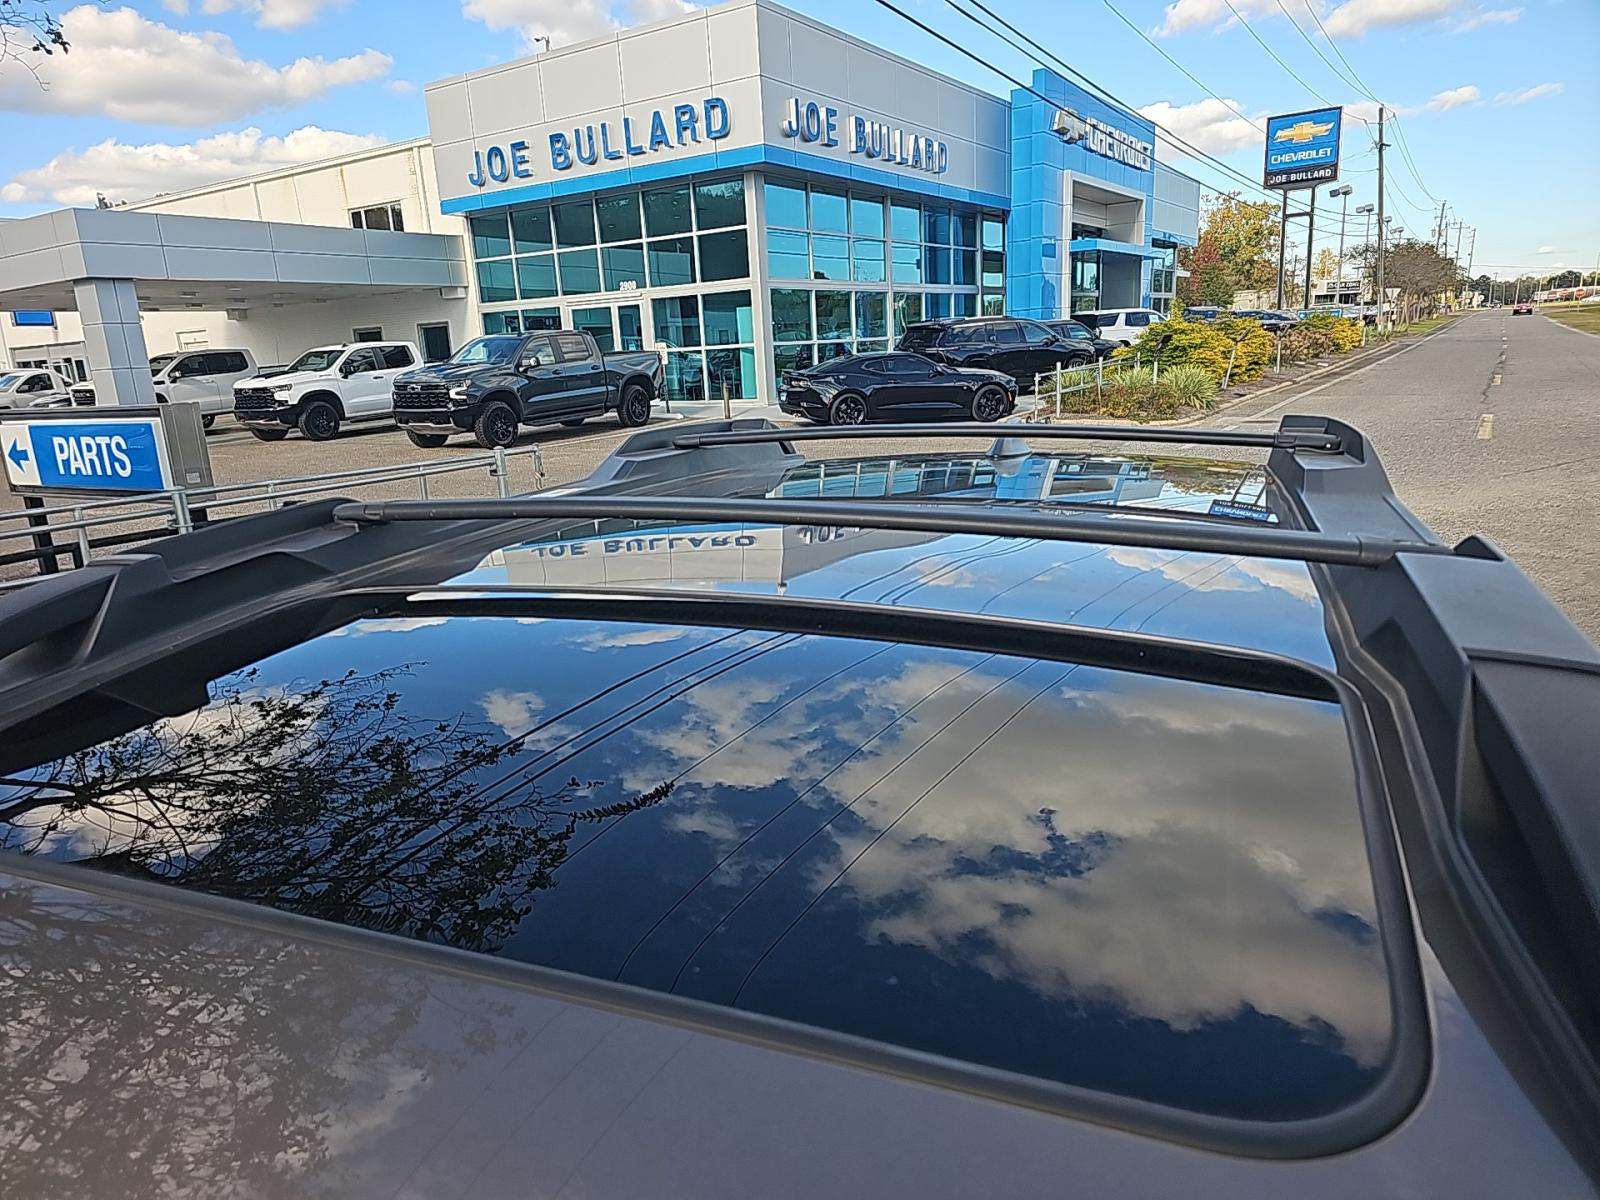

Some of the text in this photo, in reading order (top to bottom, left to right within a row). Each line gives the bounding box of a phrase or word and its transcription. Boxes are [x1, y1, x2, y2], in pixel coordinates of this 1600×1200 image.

[468, 97, 732, 187] JOE BULLARD
[782, 98, 948, 174] JOE BULLARD
[1271, 148, 1333, 164] CHEVROLET
[1270, 169, 1332, 184] JOE BULLARD
[52, 435, 132, 478] PARTS
